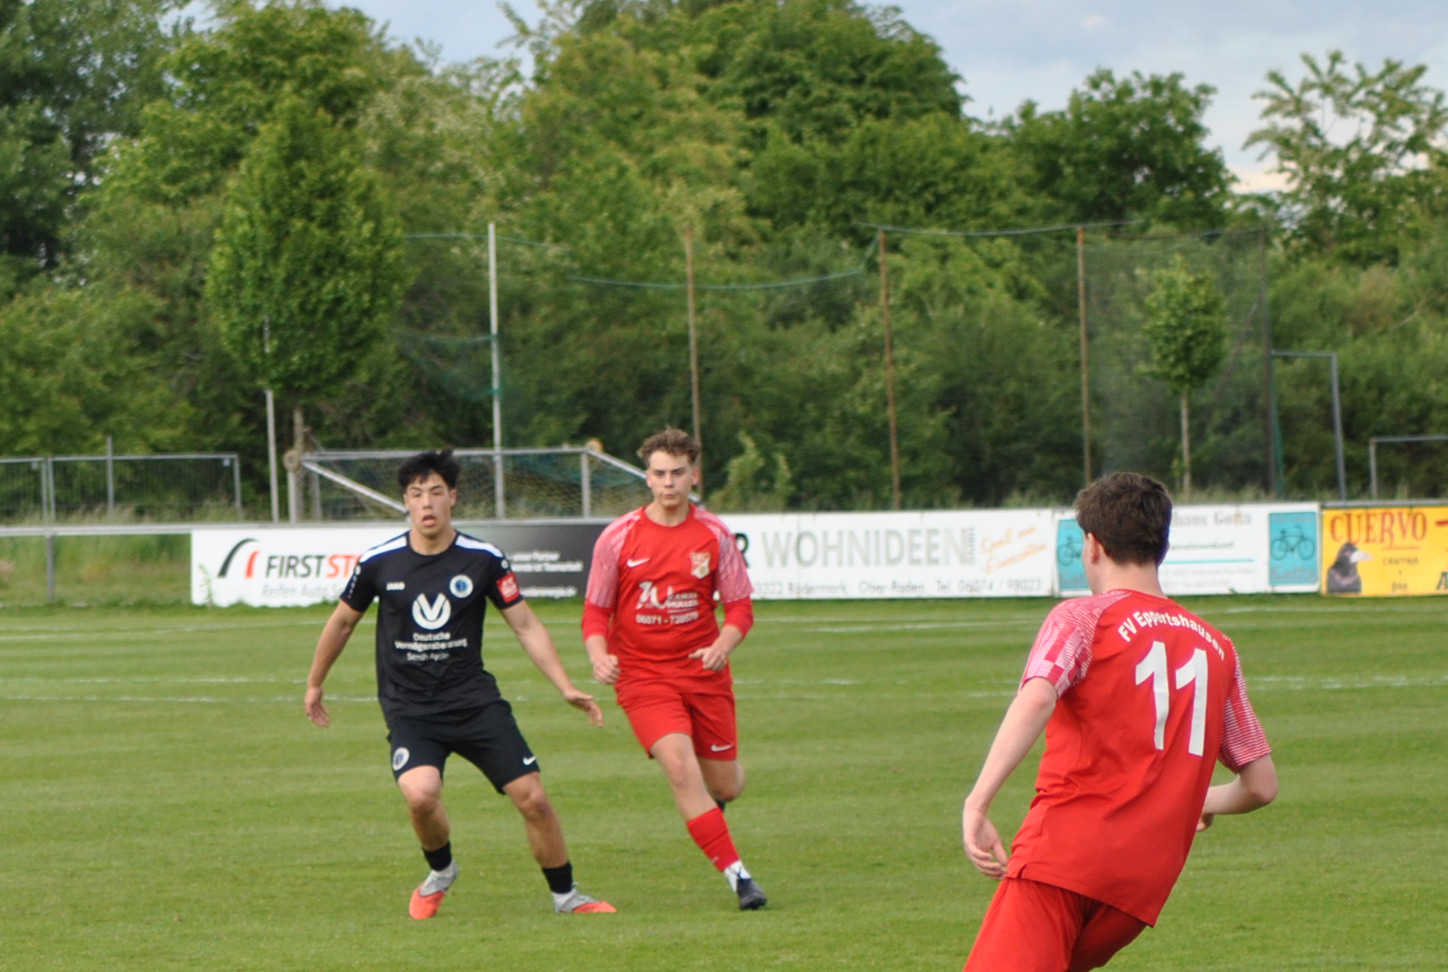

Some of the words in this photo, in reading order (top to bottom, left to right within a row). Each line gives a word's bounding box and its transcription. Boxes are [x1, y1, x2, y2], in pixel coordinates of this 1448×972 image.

[761, 528, 969, 568] WOHNIDEEN
[1329, 511, 1427, 546] CUERVO
[1117, 617, 1137, 643] FV
[1133, 611, 1225, 661] Eppertshausen
[1135, 640, 1209, 757] 11
